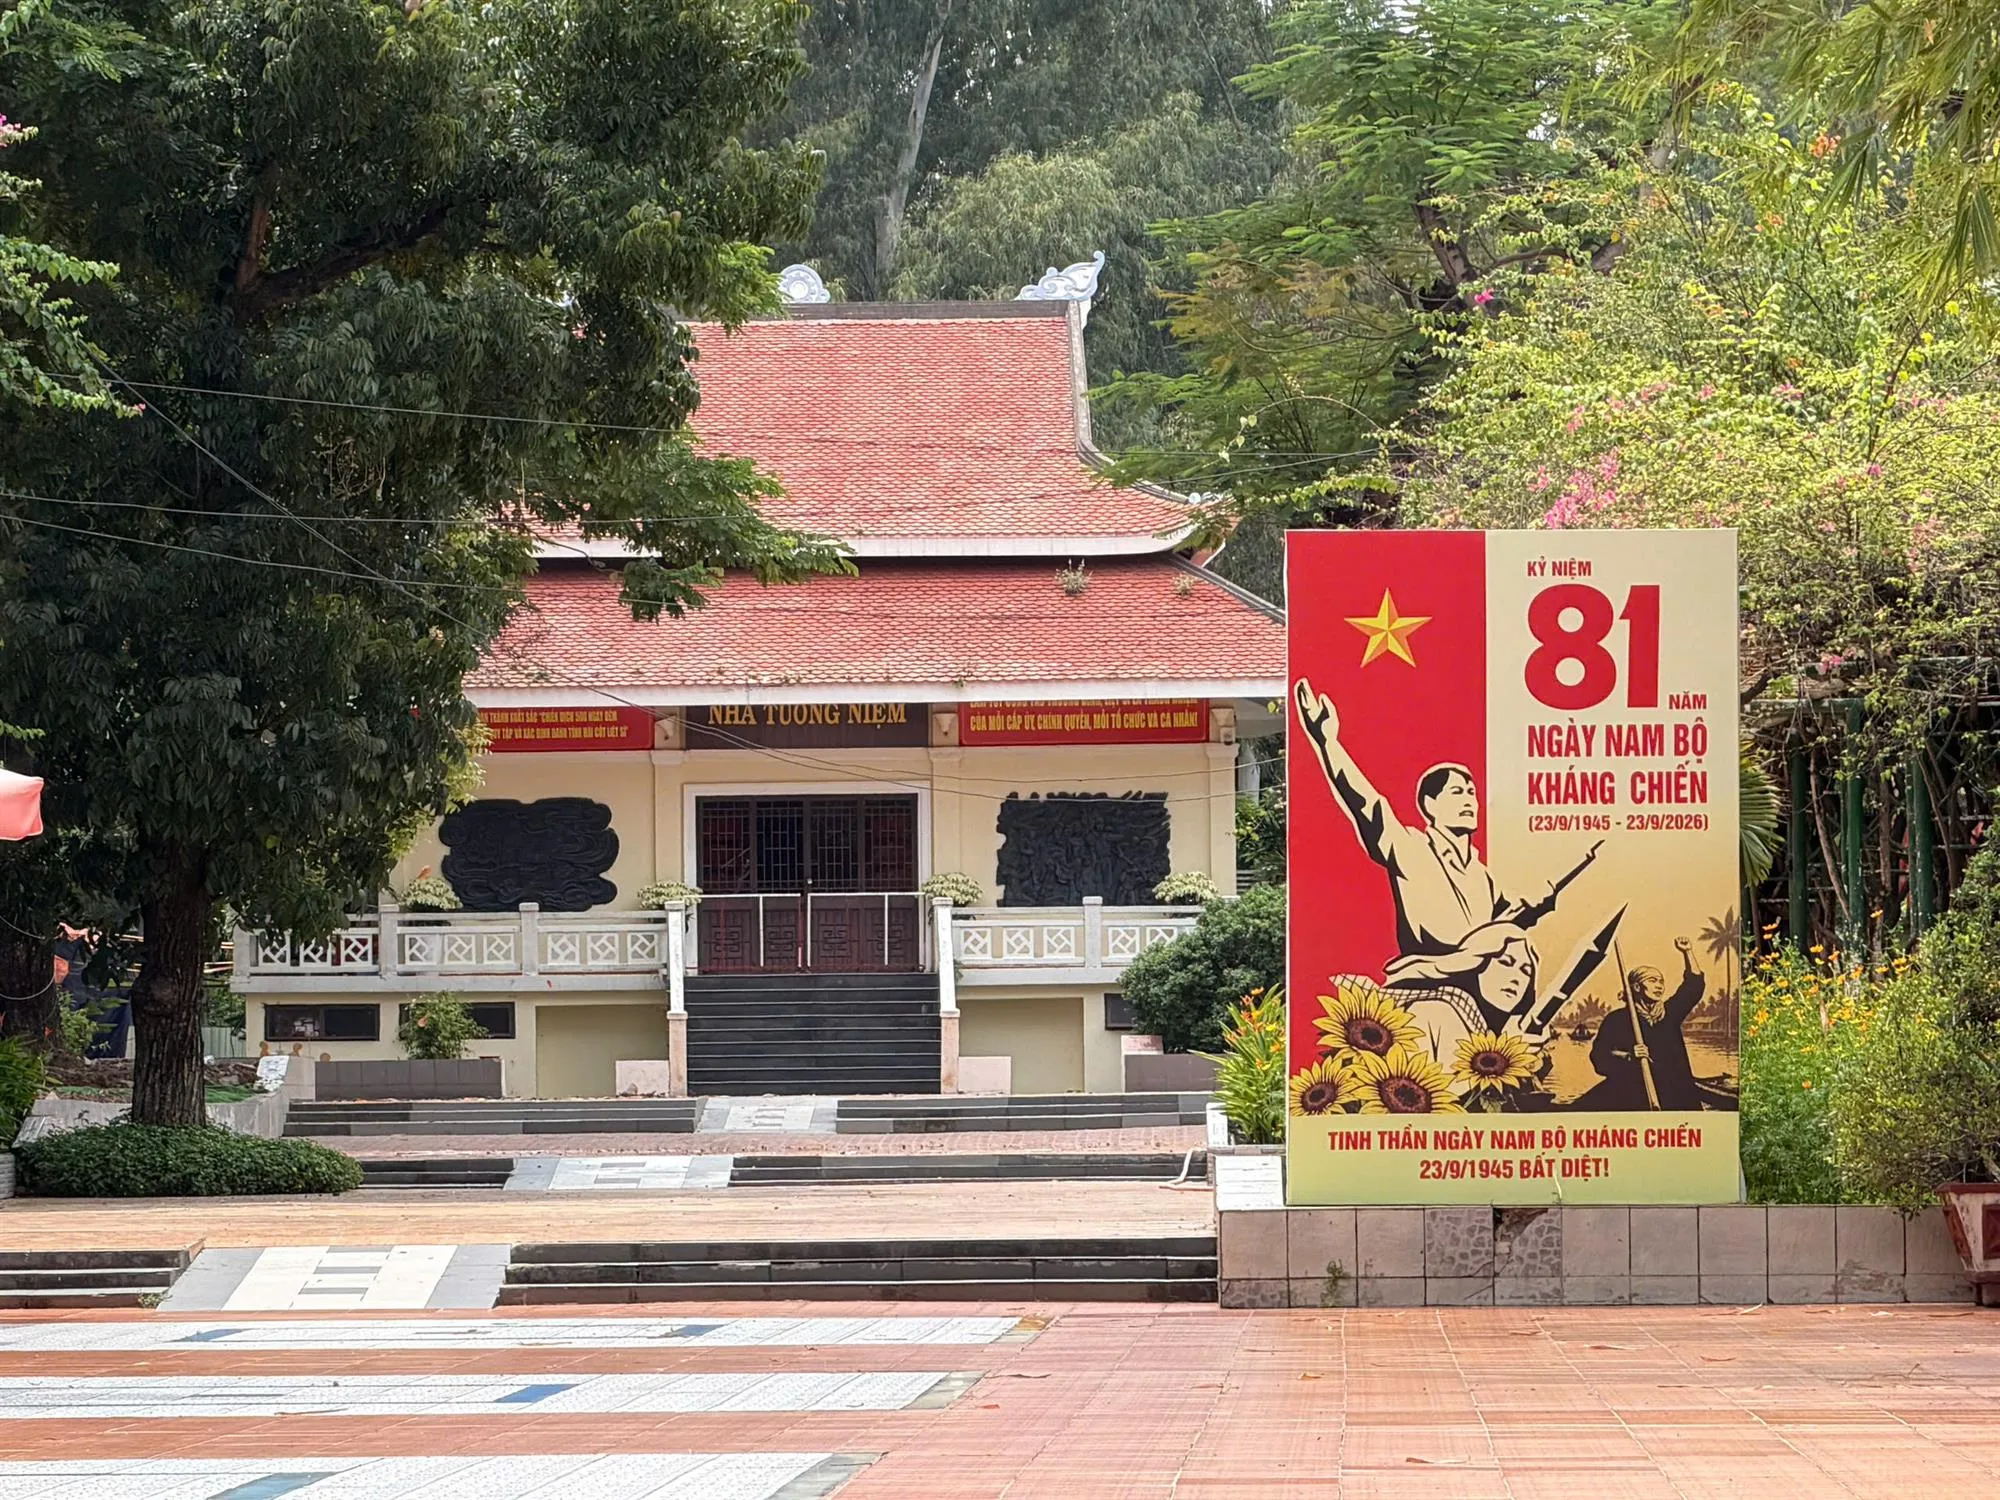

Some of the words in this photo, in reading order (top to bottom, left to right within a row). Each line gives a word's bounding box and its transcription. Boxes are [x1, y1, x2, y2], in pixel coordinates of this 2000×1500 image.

[1527, 555, 1547, 577] KỶ
[1551, 557, 1592, 580] NIỆM
[1525, 583, 1660, 711] 81
[1668, 692, 1707, 710] NĂM
[1528, 717, 1596, 758] NGÀY
[1605, 724, 1664, 757] NAM
[1673, 717, 1707, 764] BỘ
[1528, 765, 1615, 805] KHÁNG
[1630, 761, 1707, 805] CHIẾN
[1529, 815, 1611, 833] (23/9/1945
[1626, 814, 1709, 832] 23/9/2026)
[1328, 1131, 1371, 1151] TINH
[1377, 1124, 1427, 1150] THẦN
[1434, 1126, 1484, 1150] NGÀY
[1490, 1130, 1535, 1150] NAM
[1541, 1126, 1566, 1153] BỘ
[1572, 1125, 1638, 1149] KHÁNG
[1644, 1122, 1701, 1148] CHIẾN
[1419, 1160, 1514, 1180] 23/9/1945
[1520, 1152, 1556, 1179] BẤT
[1561, 1154, 1609, 1181] DIỆT!
